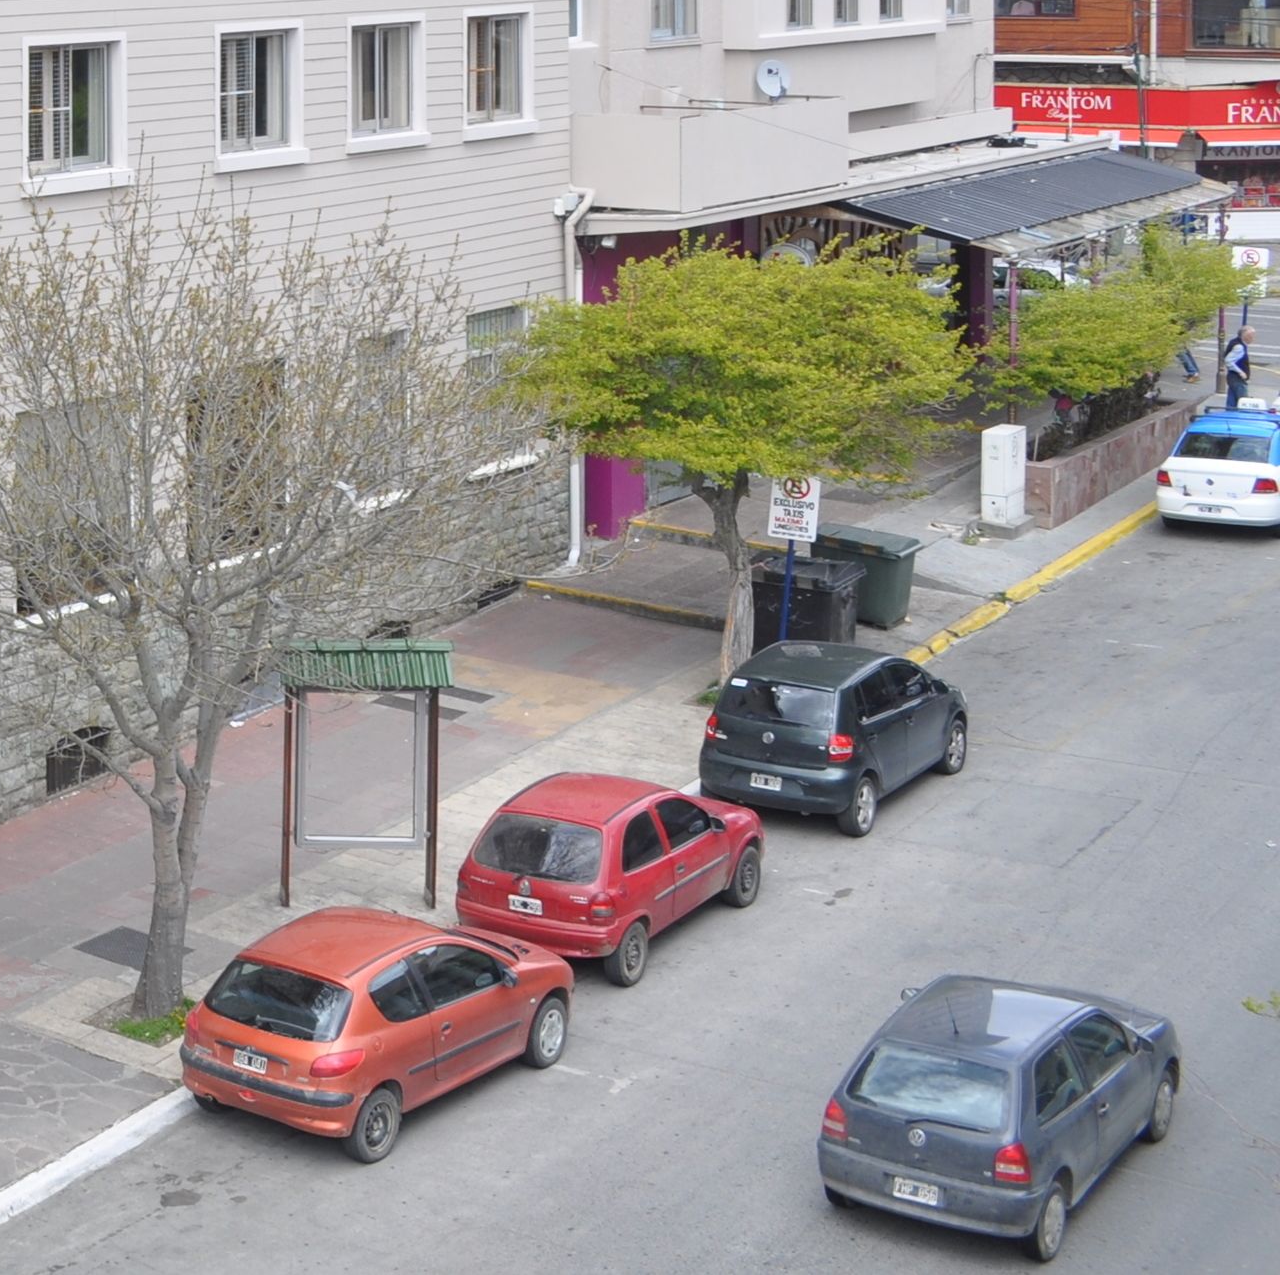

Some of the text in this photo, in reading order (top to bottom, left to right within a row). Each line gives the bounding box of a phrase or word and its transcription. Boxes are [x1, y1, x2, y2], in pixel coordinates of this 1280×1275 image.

[1021, 91, 1112, 111] FRANTOM
[774, 497, 815, 511] EXCLUSIVO
[783, 508, 805, 519] TAXIS
